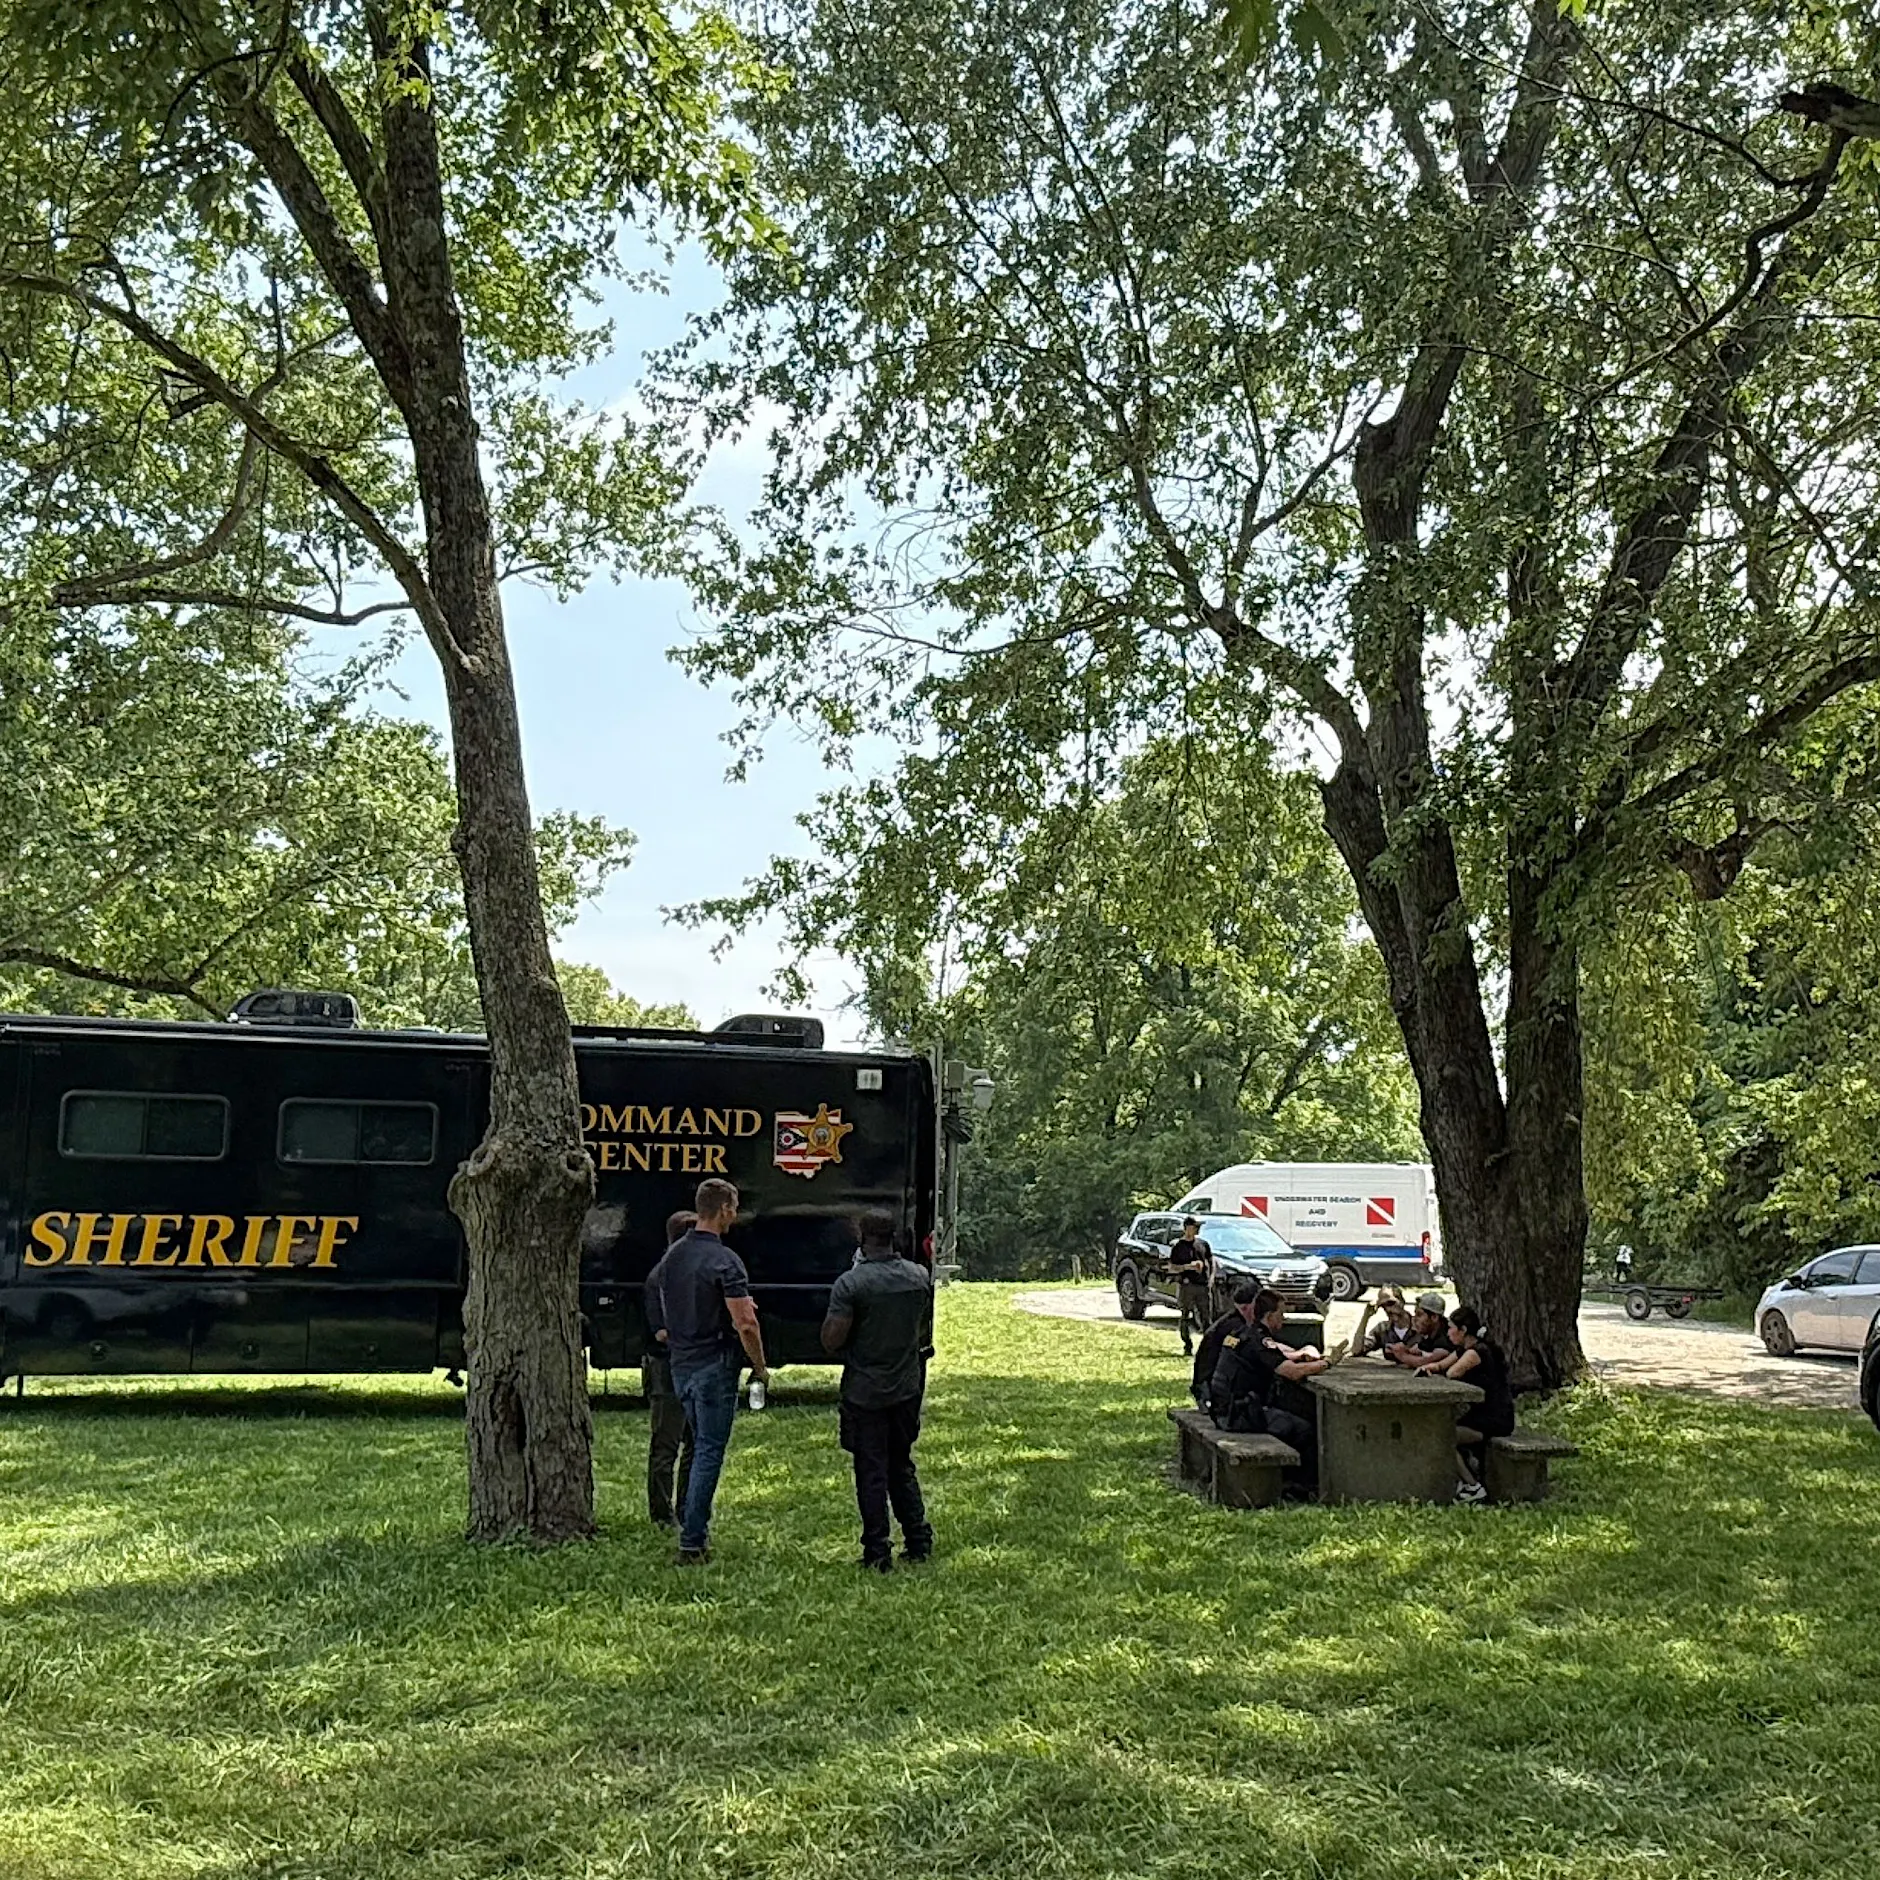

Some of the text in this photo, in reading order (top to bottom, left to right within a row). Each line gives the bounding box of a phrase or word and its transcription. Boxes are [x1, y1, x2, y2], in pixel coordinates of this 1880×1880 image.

[583, 1141, 728, 1173] ENTER
[23, 1211, 359, 1268] SHERIFF
[1295, 1220, 1338, 1228] RECOVERY
